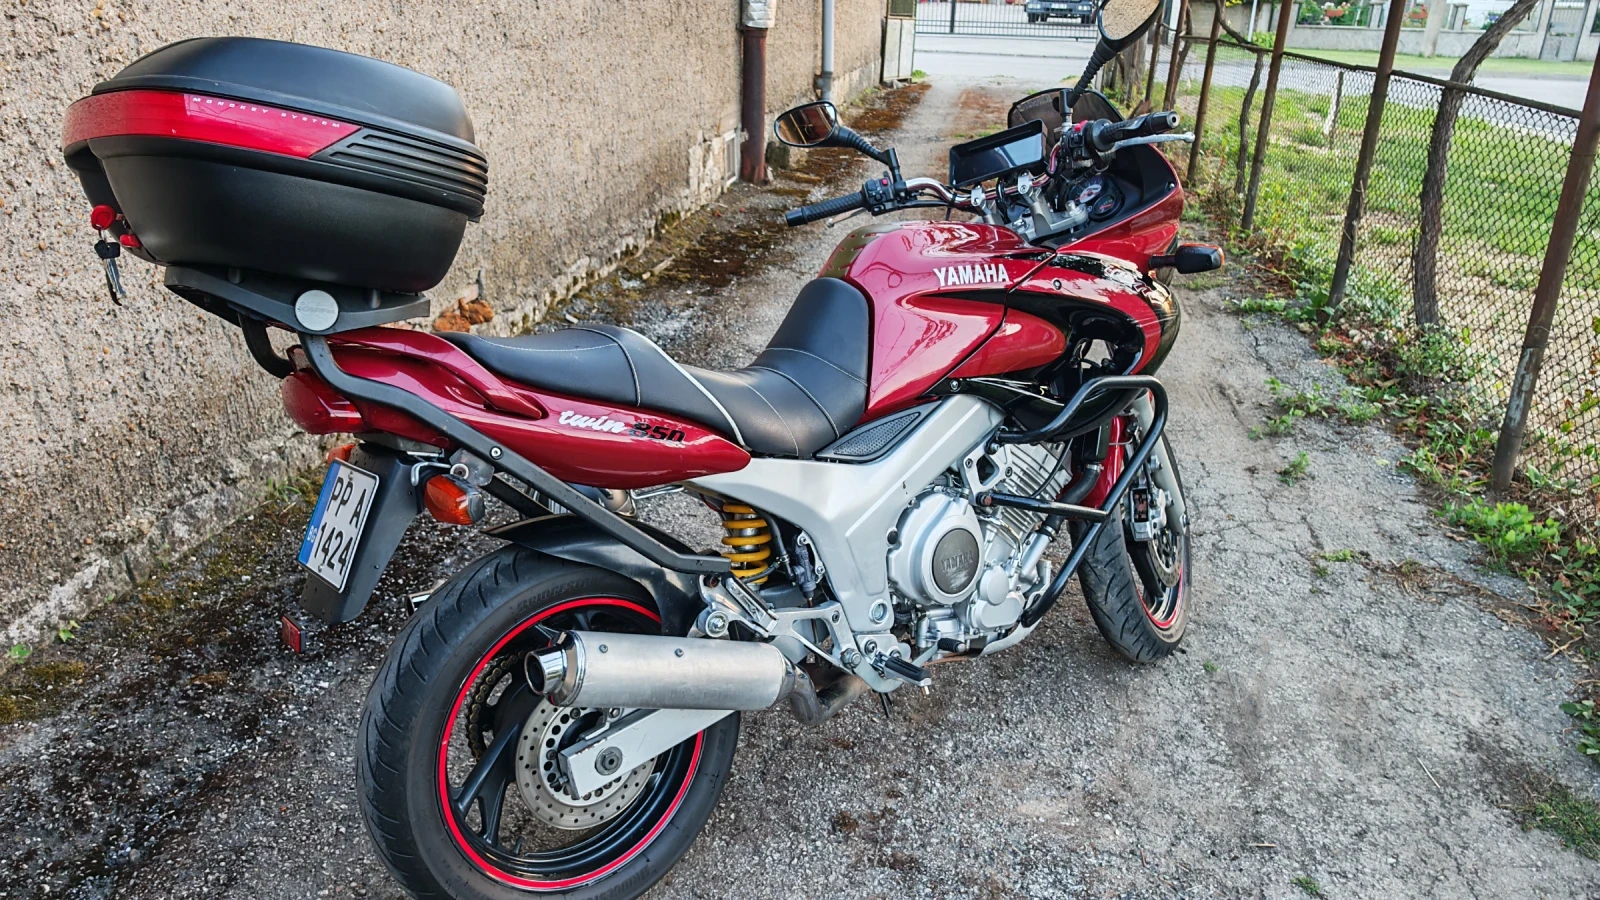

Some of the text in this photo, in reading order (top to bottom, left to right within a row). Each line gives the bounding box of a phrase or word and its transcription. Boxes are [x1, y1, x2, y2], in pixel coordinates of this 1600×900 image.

[192, 97, 339, 127] MONOKEY SYSTEM
[933, 263, 1010, 287] YAMAHA
[558, 410, 686, 443] twin 850
[326, 476, 367, 529] PP A
[314, 522, 353, 575] 1424
[940, 550, 974, 572] YAMAHA
